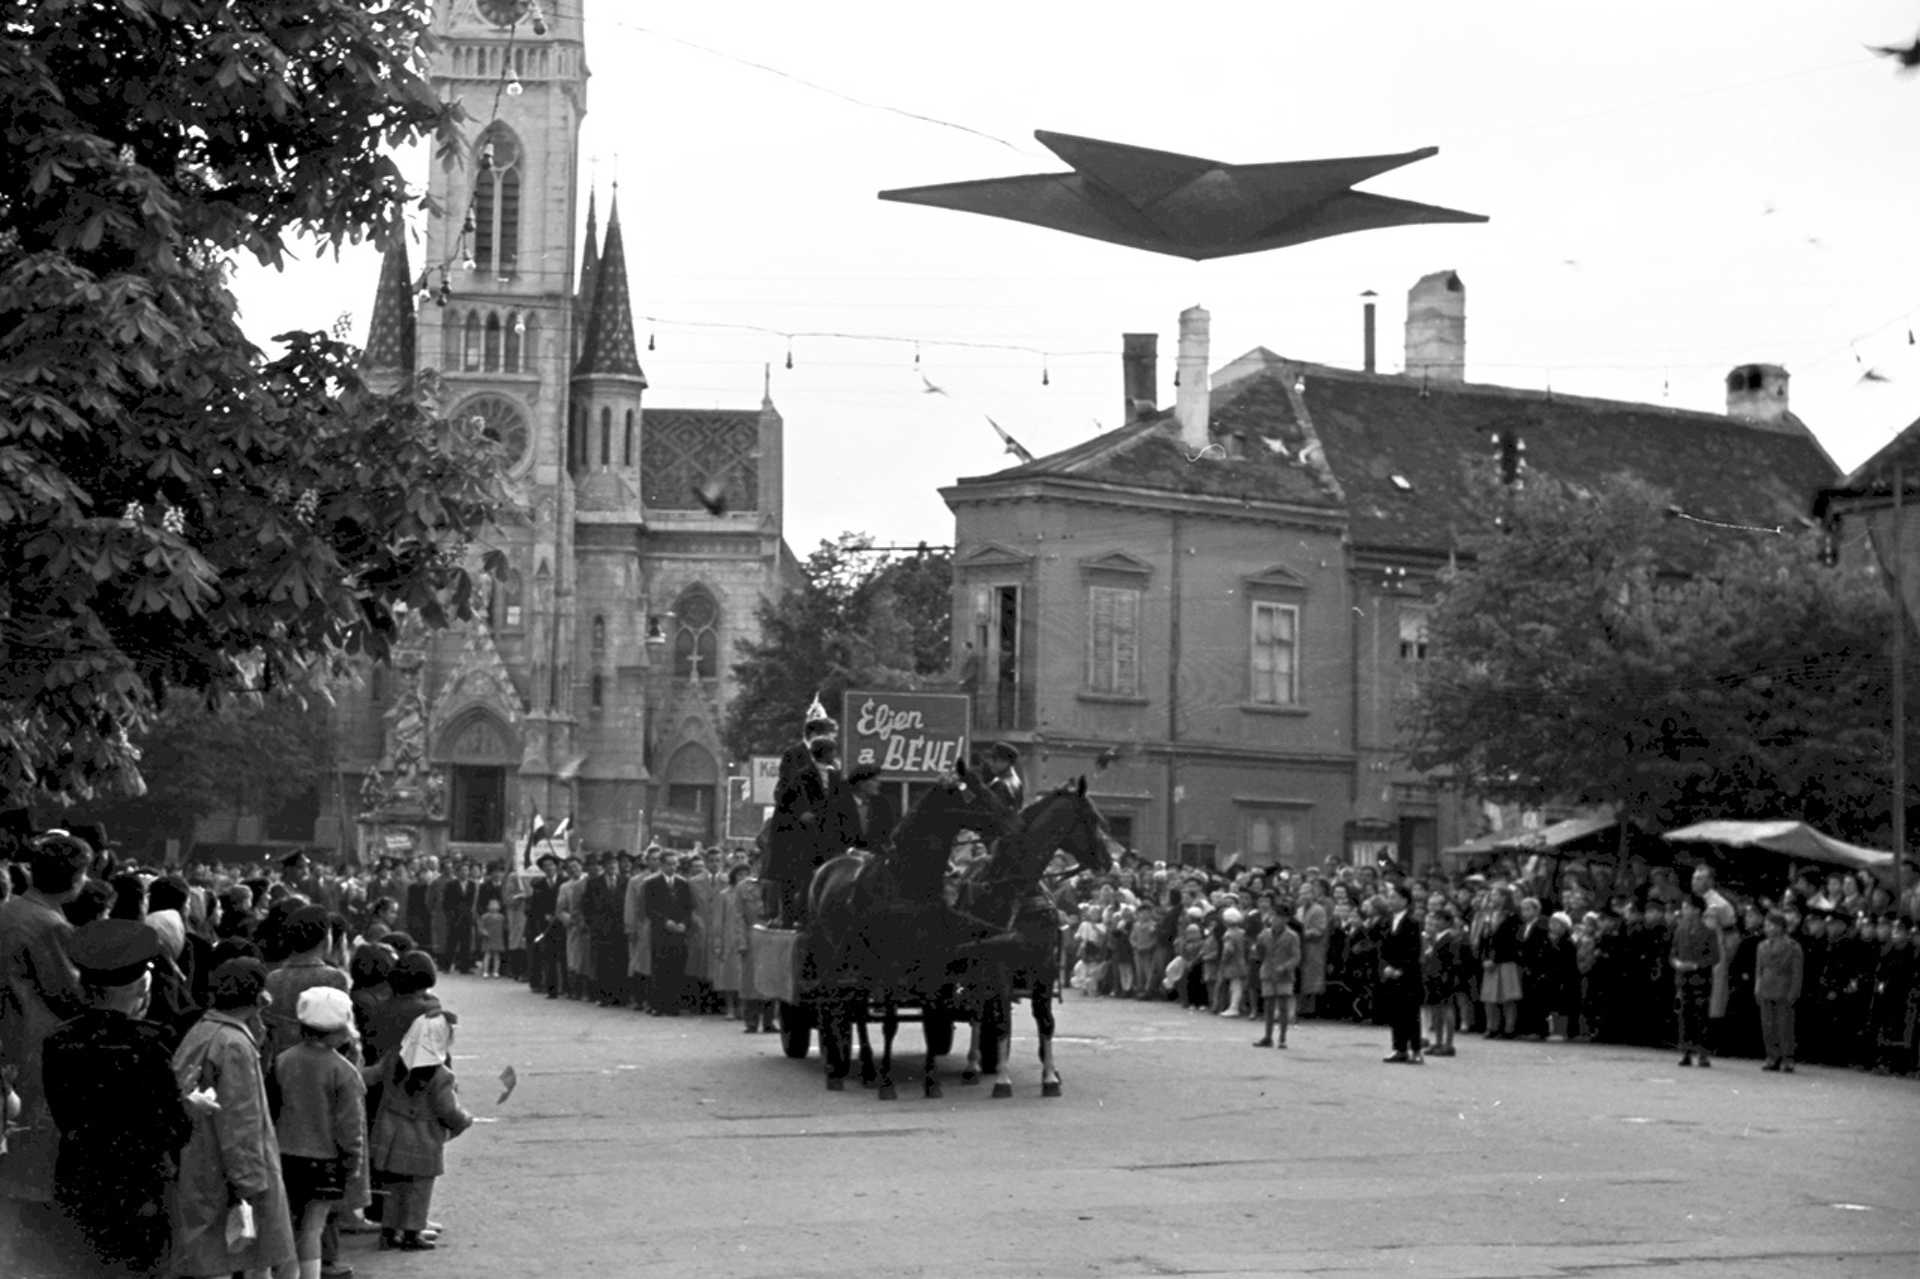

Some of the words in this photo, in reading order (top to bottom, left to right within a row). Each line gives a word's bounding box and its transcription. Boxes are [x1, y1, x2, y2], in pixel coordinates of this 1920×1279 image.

[857, 698, 924, 740] Éljen
[858, 748, 875, 764] a
[881, 734, 964, 771] BÉKE!
